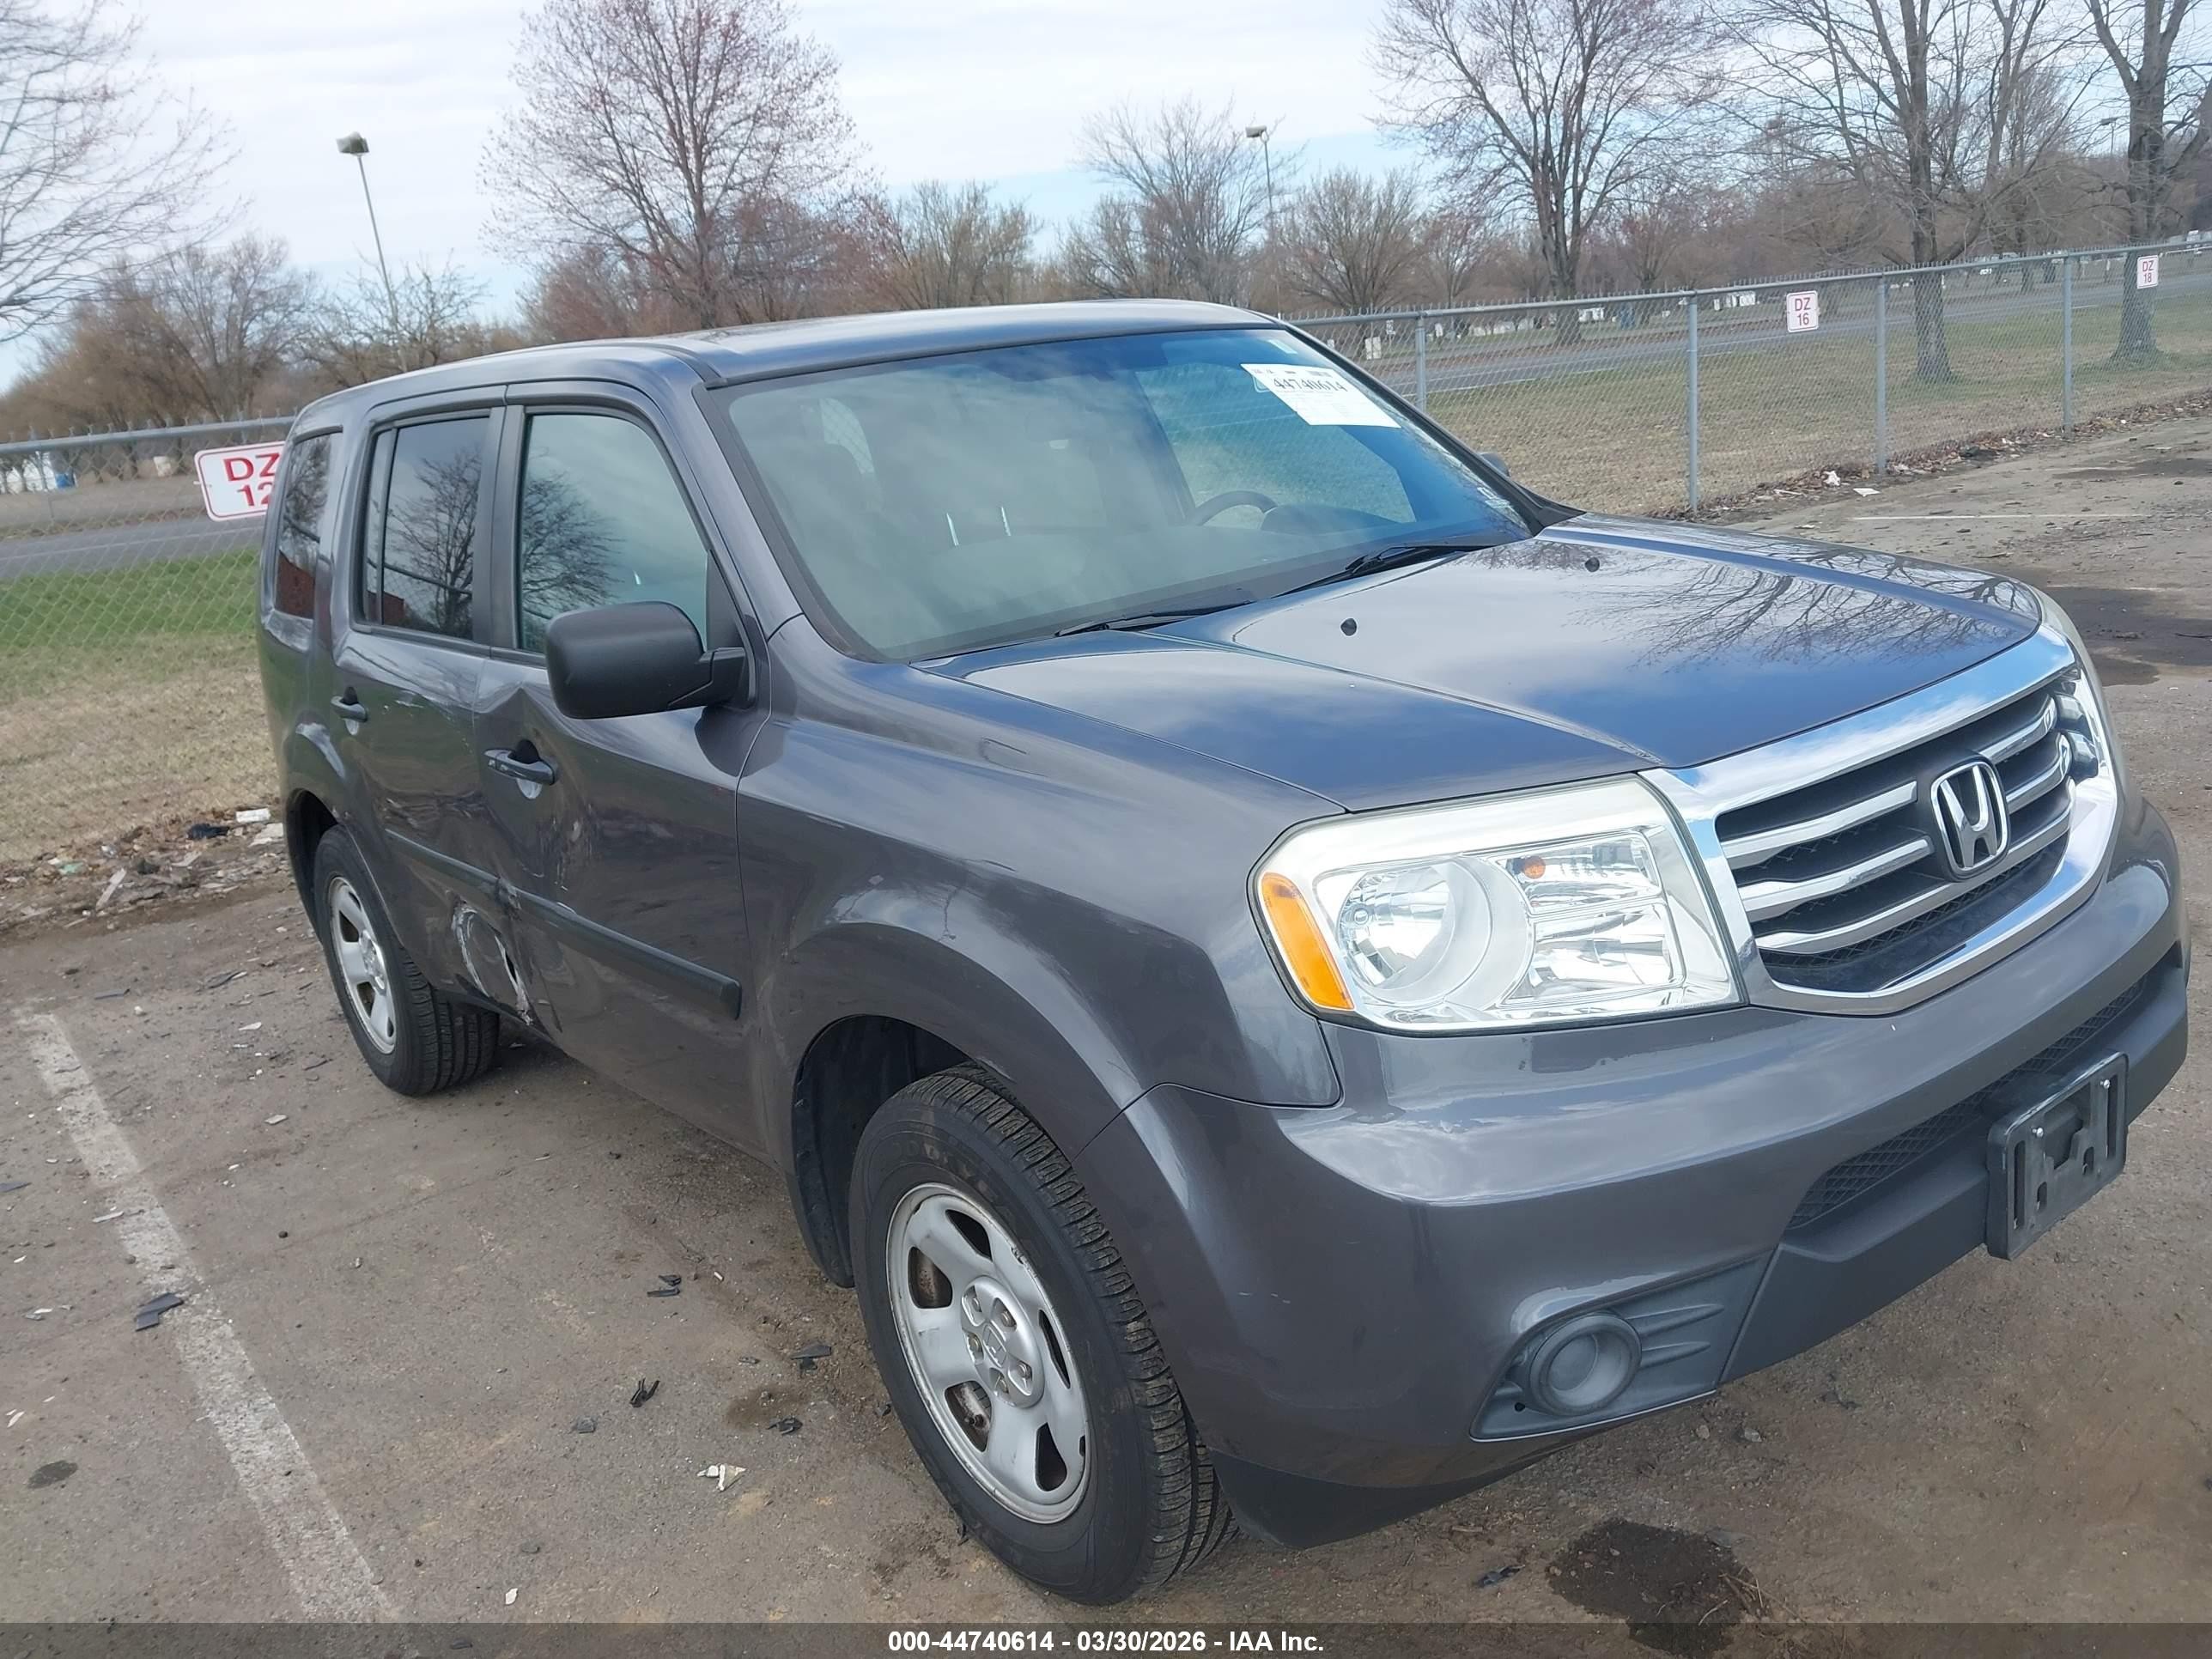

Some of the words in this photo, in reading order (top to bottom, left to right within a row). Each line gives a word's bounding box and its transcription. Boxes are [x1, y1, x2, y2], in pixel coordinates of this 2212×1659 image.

[2142, 260, 2154, 272] DZ
[2143, 272, 2152, 283] 18
[1795, 297, 1811, 311] DZ
[1797, 313, 1809, 325] 16
[1273, 377, 1348, 392] 44740614
[222, 453, 280, 481] DZ
